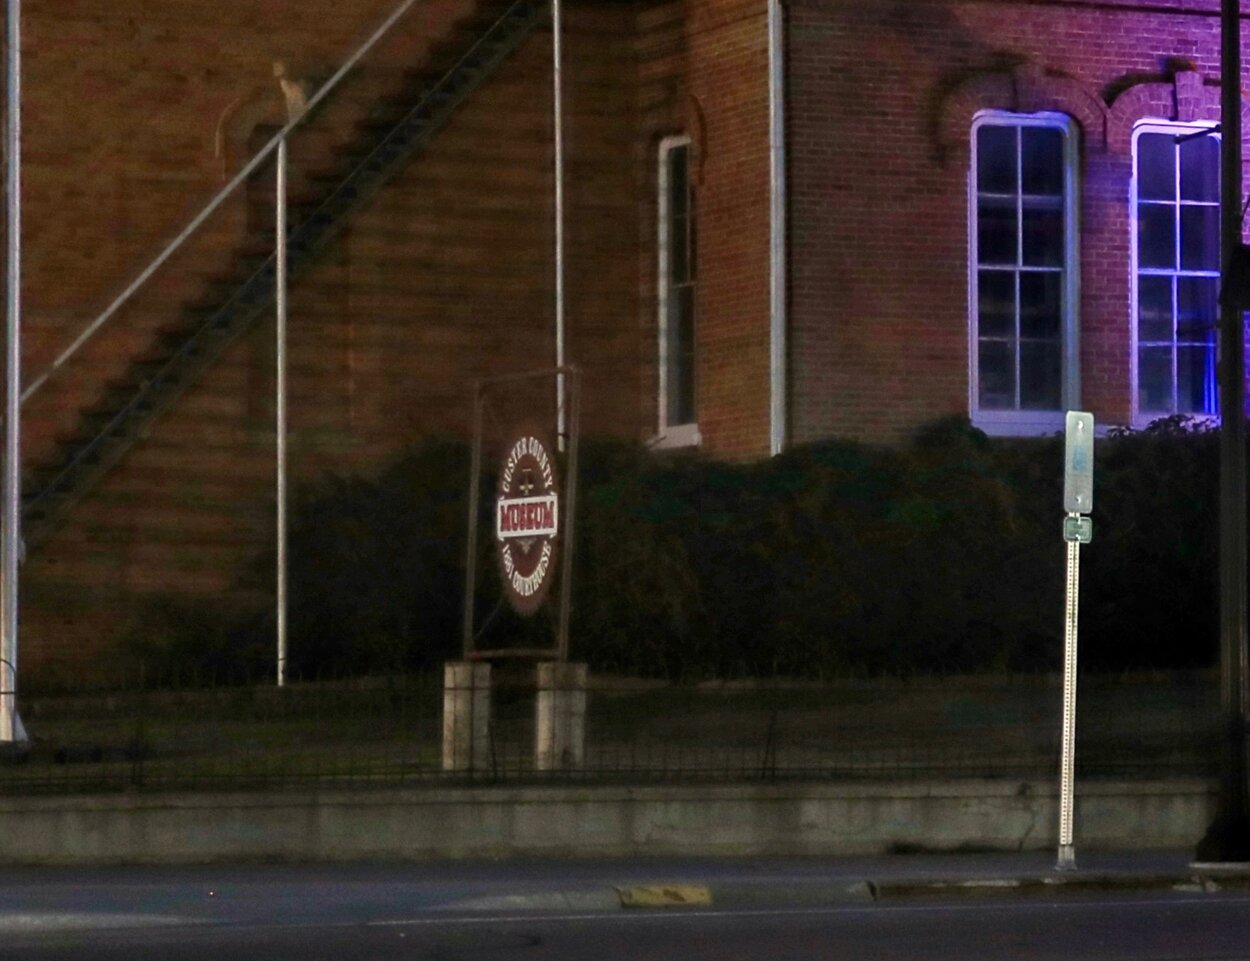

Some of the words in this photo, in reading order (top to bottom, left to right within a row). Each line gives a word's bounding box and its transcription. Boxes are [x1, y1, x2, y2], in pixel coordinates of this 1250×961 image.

[502, 437, 527, 493] CUSTER
[528, 436, 553, 489] COUNTY
[500, 501, 555, 532] MUSEUM
[512, 540, 552, 597] COURTHOUSE
